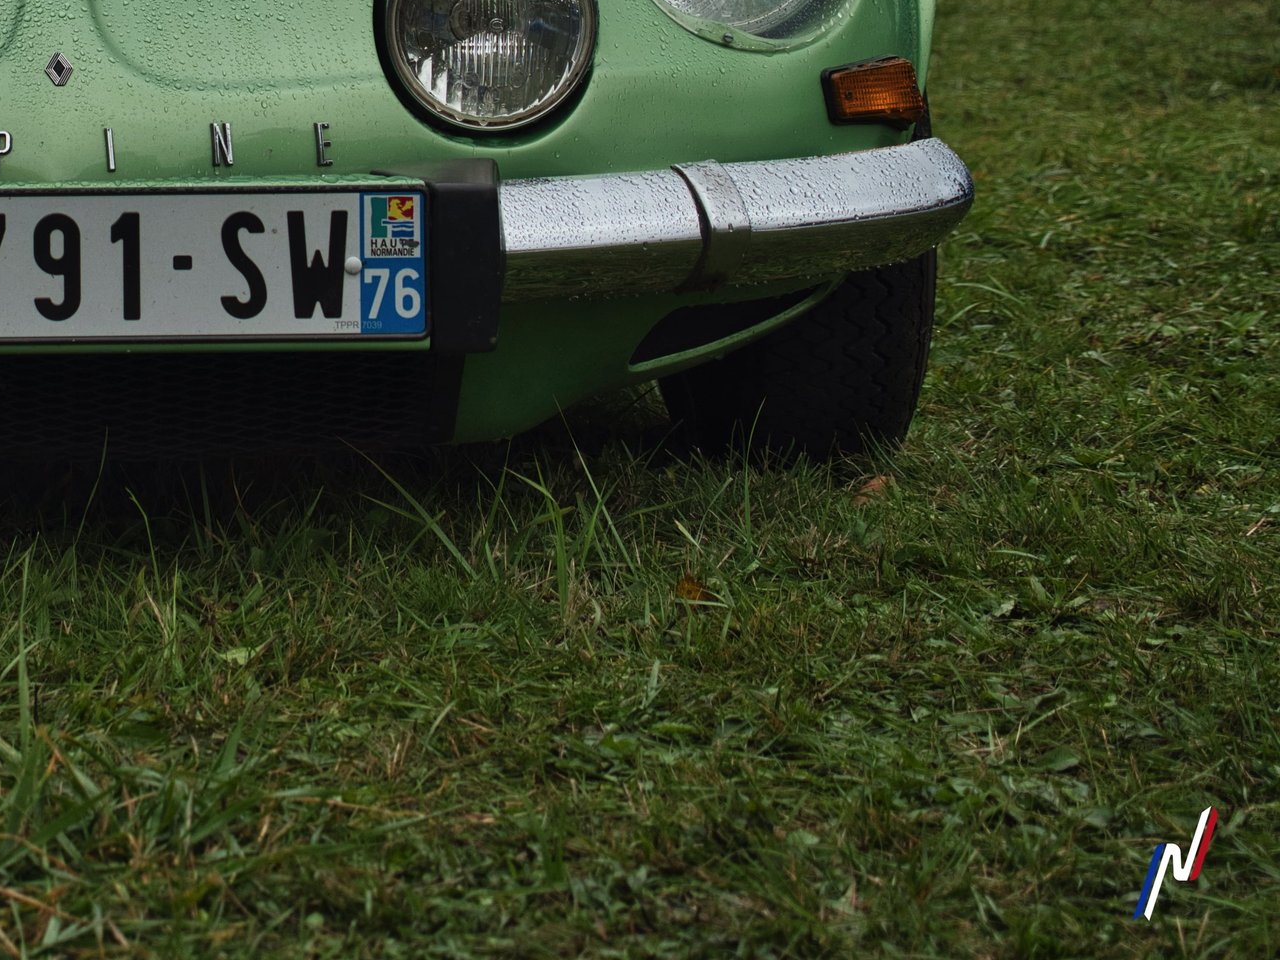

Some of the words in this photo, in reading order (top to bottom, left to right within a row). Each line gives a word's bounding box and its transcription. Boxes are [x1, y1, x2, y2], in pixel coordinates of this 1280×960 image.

[370, 238, 419, 249] HAUT
[370, 247, 415, 257] NORMANDIE
[364, 268, 421, 319] 76
[335, 321, 359, 330] TPPR
